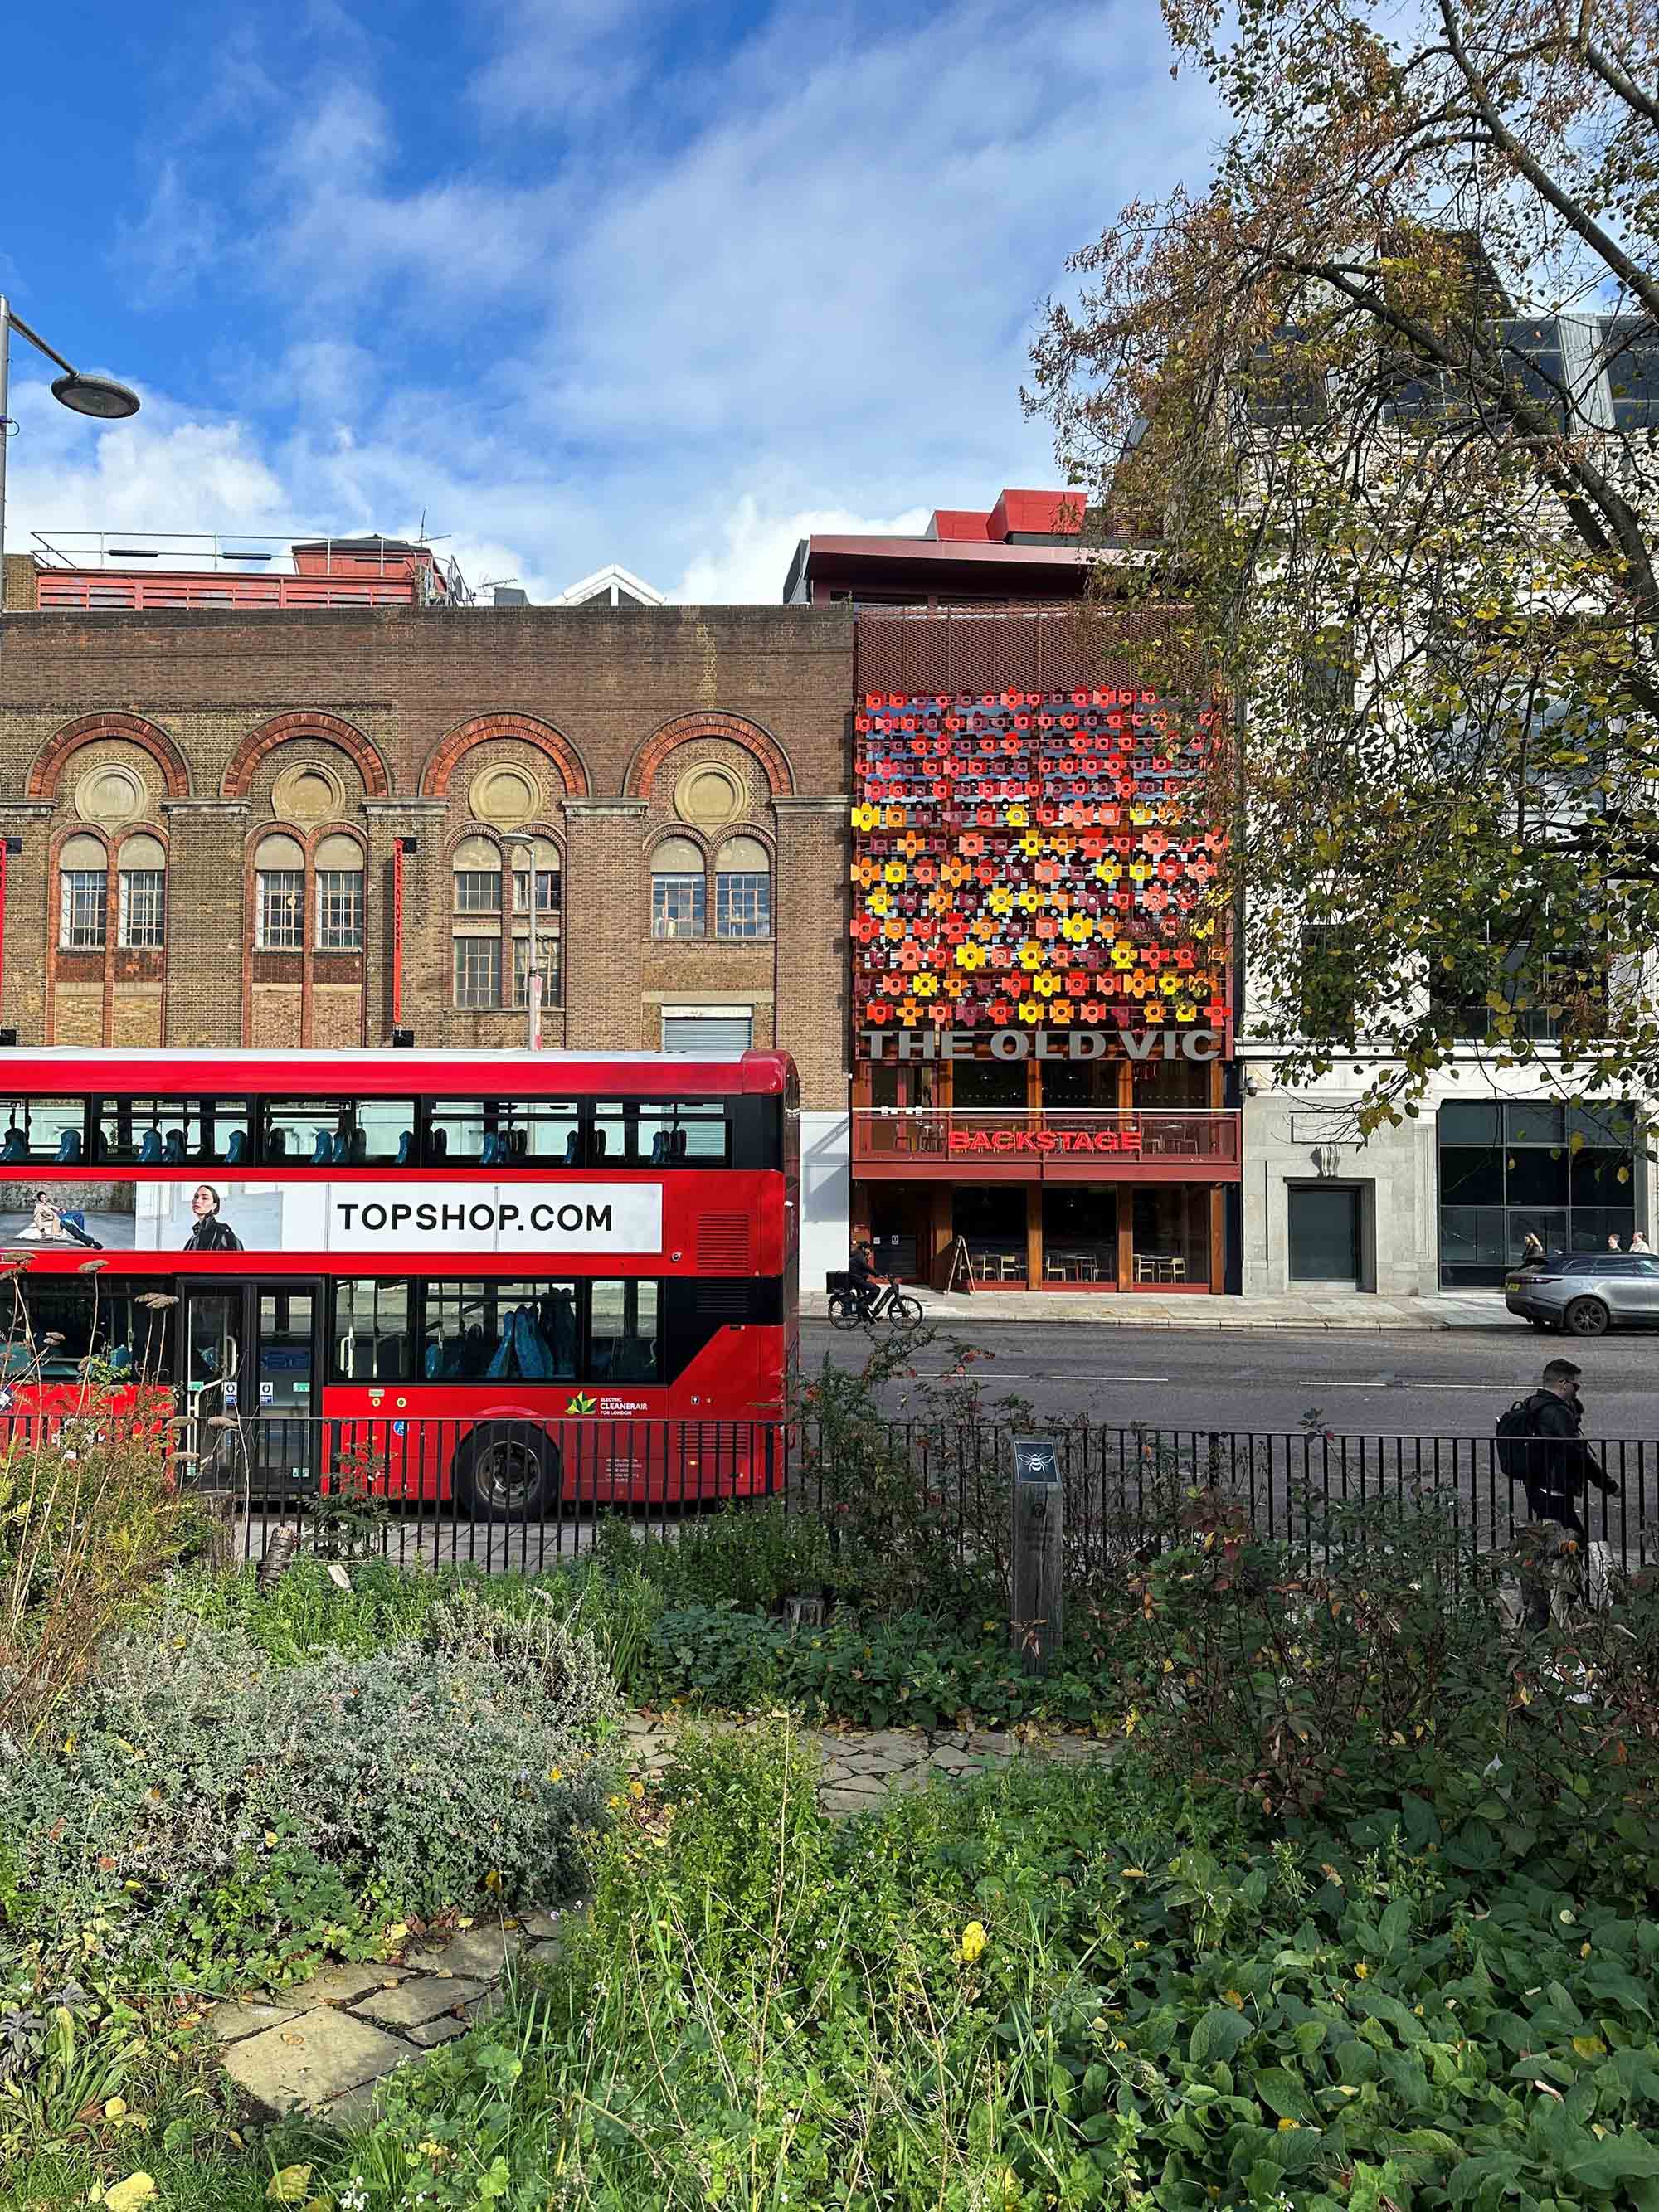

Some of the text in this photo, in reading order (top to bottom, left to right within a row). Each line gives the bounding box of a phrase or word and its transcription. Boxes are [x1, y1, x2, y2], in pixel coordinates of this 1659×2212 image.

[860, 1029, 1222, 1062] THE OLD VIC
[948, 1130, 1141, 1150] BACKSTAGE
[337, 1203, 612, 1231] TOPSHOP.COM
